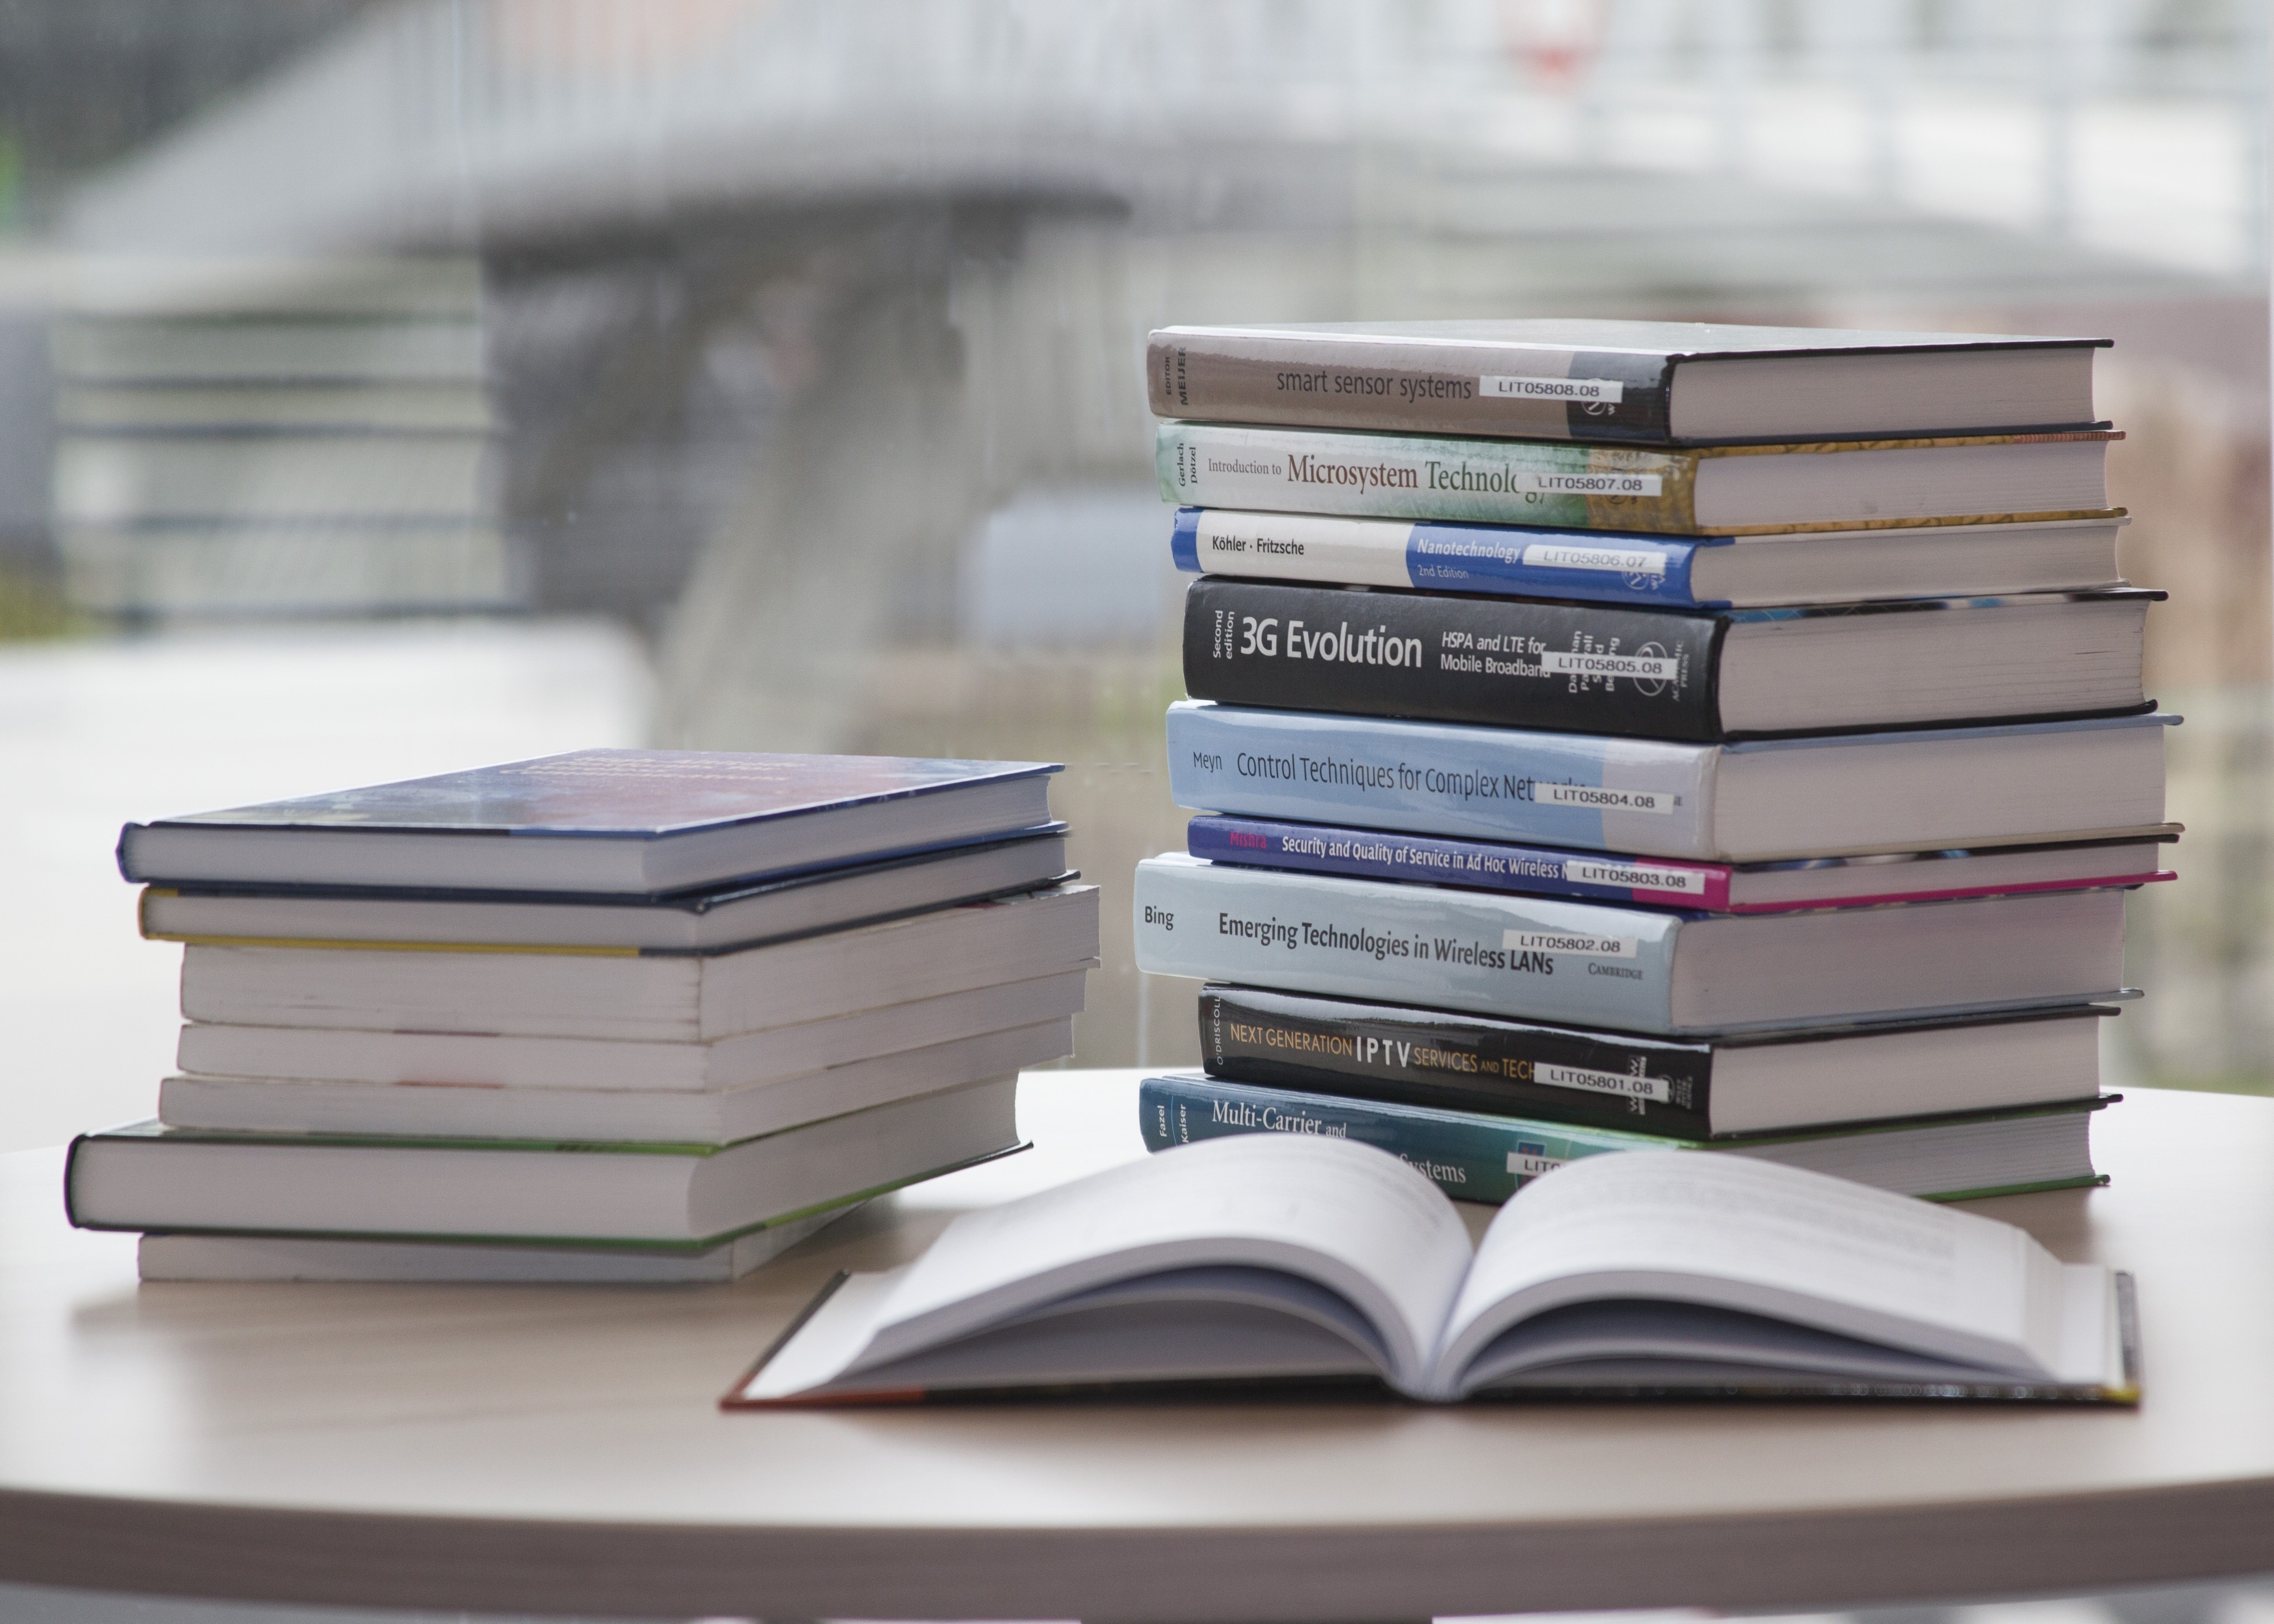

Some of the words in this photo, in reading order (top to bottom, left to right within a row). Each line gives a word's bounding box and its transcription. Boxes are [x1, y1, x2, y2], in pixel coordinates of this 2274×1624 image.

[1178, 346, 1189, 405] MEIJER
[1277, 370, 1328, 392] smart
[1335, 374, 1393, 396] sensor
[1400, 375, 1472, 403] systems
[1499, 381, 1600, 397] LIT05808.08
[1208, 459, 1268, 475] Introduction
[1272, 462, 1281, 475] to
[1287, 454, 1418, 494] Microsystem
[1538, 476, 1643, 491] LIT05807.08
[1213, 535, 1246, 552] Köhler
[1257, 538, 1304, 555] Fritzsche
[1417, 538, 1521, 564] Nanotechnology
[1417, 565, 1435, 577] 2nd
[1438, 566, 1469, 579] Edition
[1544, 551, 1647, 568] LIT05806.07
[1213, 610, 1223, 658] Second
[1224, 611, 1235, 659] edition
[1241, 616, 1278, 657] 3G
[1287, 620, 1422, 668] Evolution
[1442, 632, 1473, 649] HSPA
[1477, 634, 1501, 652] and
[1503, 636, 1525, 653] LTE
[1528, 637, 1546, 654] for
[1440, 654, 1482, 673] Mobile
[1559, 657, 1663, 674] LIT05805.08
[1193, 751, 1222, 773] Meyn
[1237, 753, 1296, 780] Control
[1299, 756, 1395, 792] Techniques
[1398, 762, 1421, 791] for
[1425, 768, 1499, 801] Complex
[1554, 788, 1656, 808] LIT05804.08
[1230, 830, 1267, 849] Mishra
[1282, 836, 1326, 859] Security
[1329, 840, 1350, 857] and
[1353, 841, 1393, 865] Quality
[1395, 846, 1408, 863] of
[1410, 848, 1450, 868] Service
[1453, 851, 1464, 869] in
[1467, 853, 1482, 872] Ad
[1484, 854, 1506, 874] Hoc
[1508, 856, 1559, 879] Wireless
[1582, 866, 1686, 888] LIT05803.08
[1145, 906, 1174, 931] Bing
[1219, 913, 1298, 949] Emerging
[1301, 922, 1409, 961] Technologies
[1414, 934, 1429, 959] in
[1435, 938, 1506, 970] Wireless
[1510, 951, 1554, 975] LANs
[1521, 935, 1621, 953] LIT05802.08
[1588, 962, 1643, 980] CAMBRIDGE
[1214, 996, 1223, 1065] O'DRISCOLL
[1230, 1024, 1263, 1044] NEXT
[1265, 1029, 1353, 1057] GENERATION
[1356, 1036, 1411, 1068] IPTV
[1414, 1047, 1478, 1073] SERVICES
[1480, 1059, 1499, 1074] AND
[1550, 1069, 1653, 1095] LIT05801.08
[1157, 1105, 1167, 1137] Fazel
[1179, 1104, 1189, 1143] Kaiser
[1212, 1100, 1322, 1134] Multi-Carrier
[1326, 1122, 1347, 1138] and
